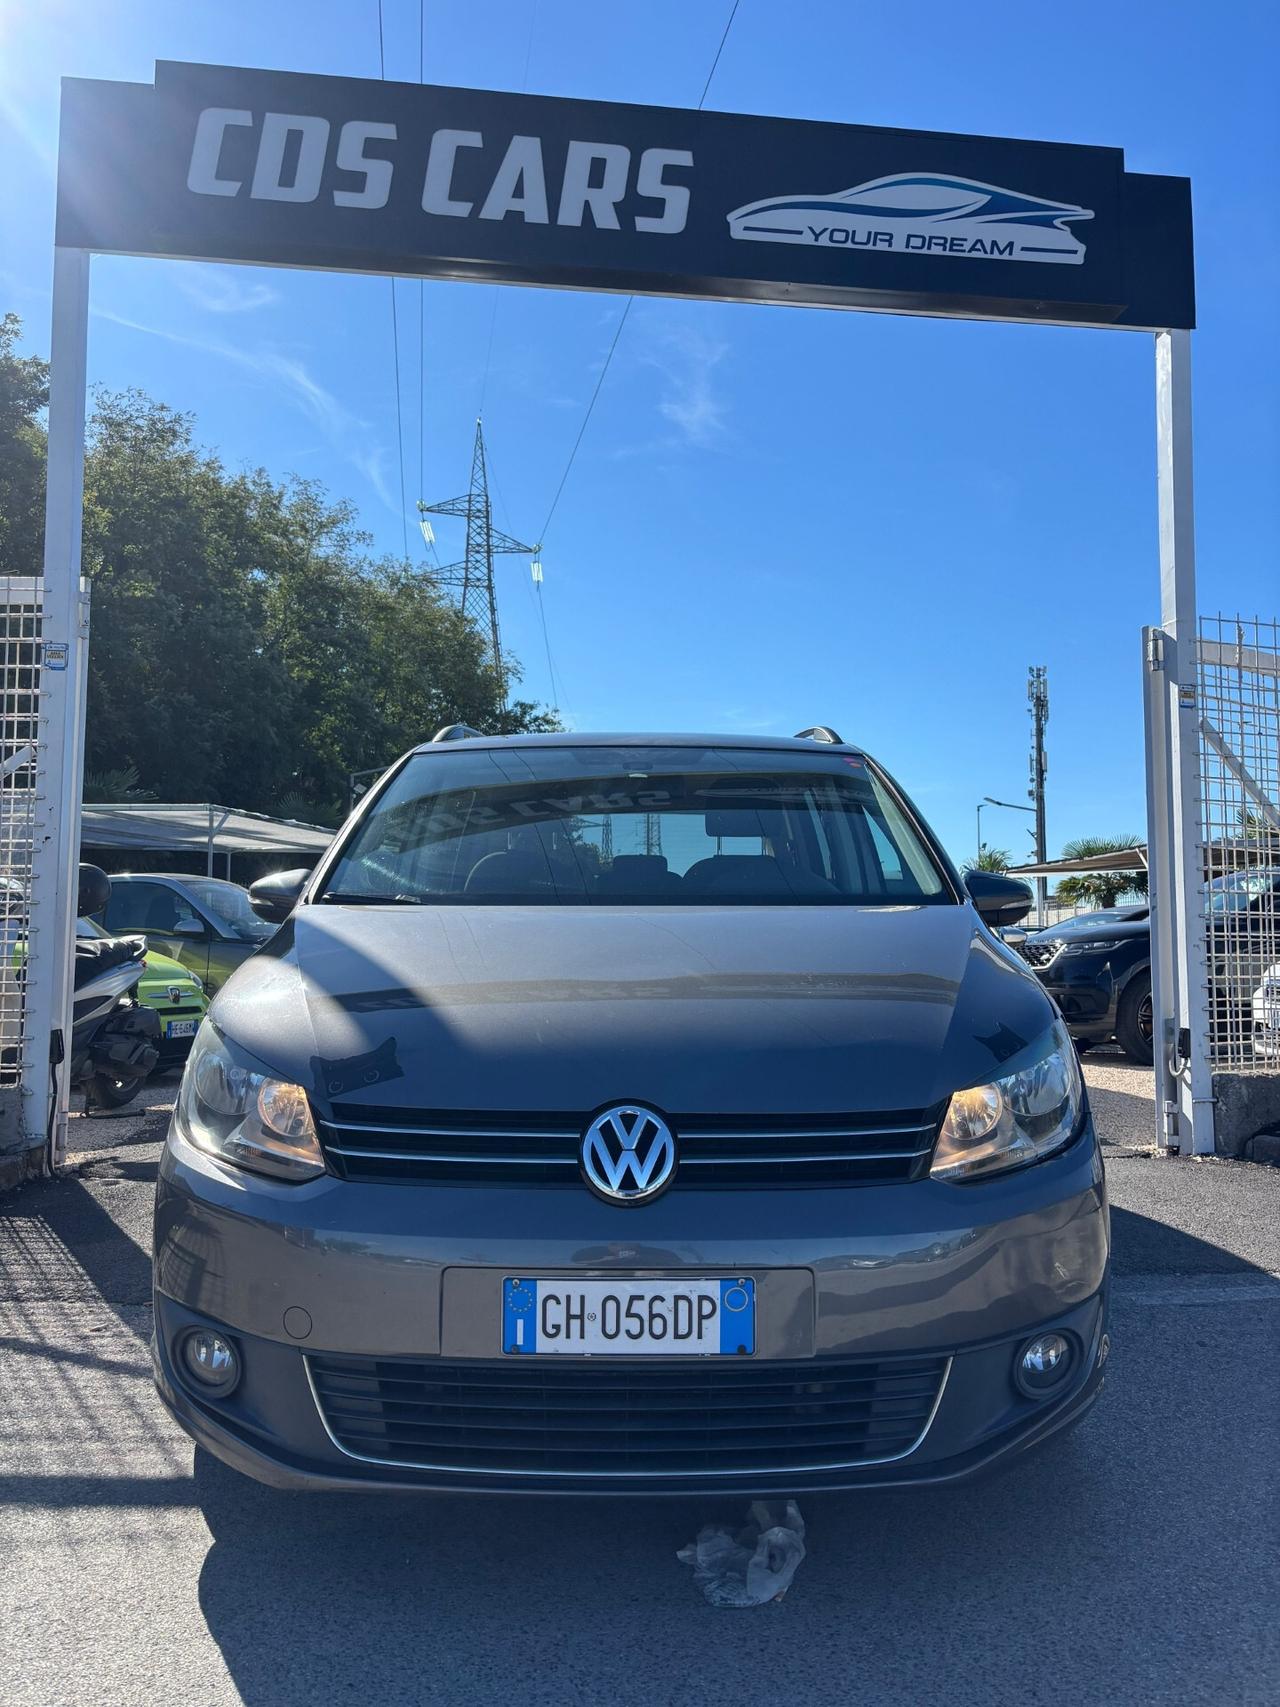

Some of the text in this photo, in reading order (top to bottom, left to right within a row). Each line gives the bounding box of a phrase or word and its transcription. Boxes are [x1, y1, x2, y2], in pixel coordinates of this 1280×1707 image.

[186, 107, 695, 234] CDS CARS
[806, 226, 1015, 257] YOUR DREAM
[584, 1107, 674, 1198] VW
